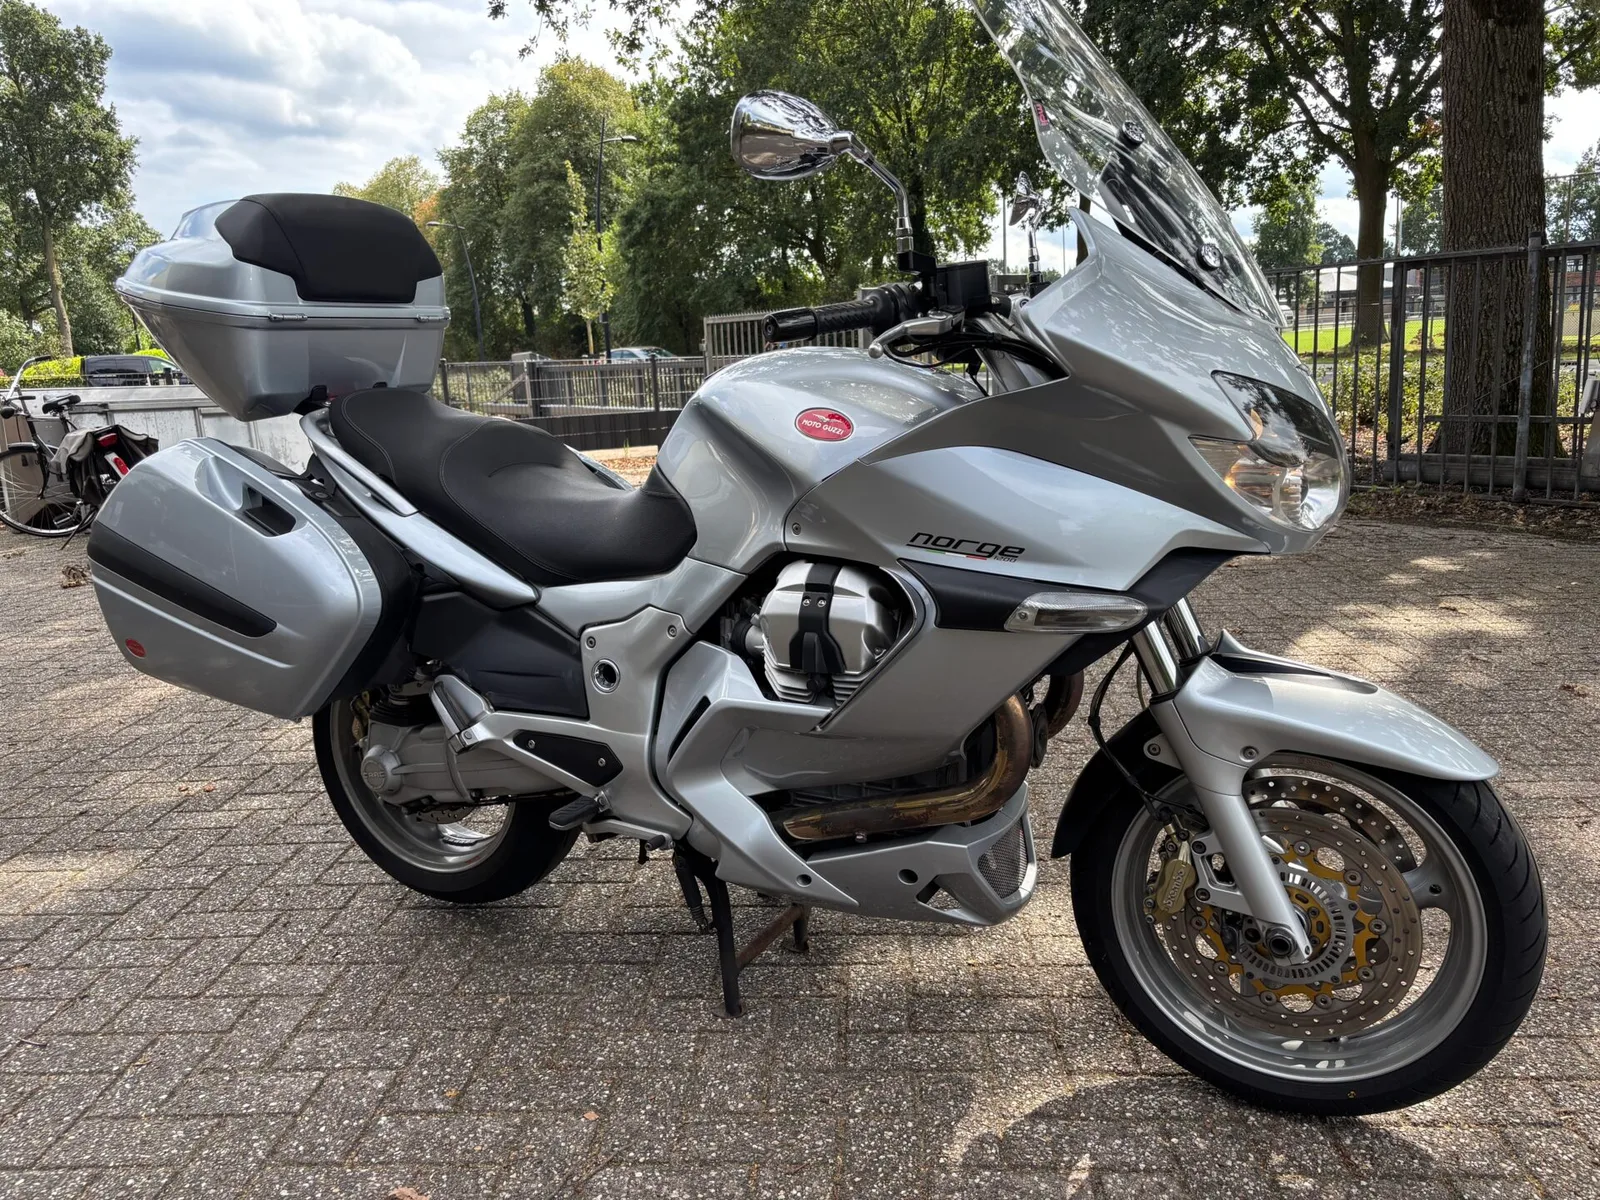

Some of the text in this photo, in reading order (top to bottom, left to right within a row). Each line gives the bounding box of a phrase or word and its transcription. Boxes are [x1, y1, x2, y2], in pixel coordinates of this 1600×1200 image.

[802, 419, 844, 435] MOTO GUZZI
[909, 532, 1025, 558] norge
[994, 555, 1017, 564] 1200
